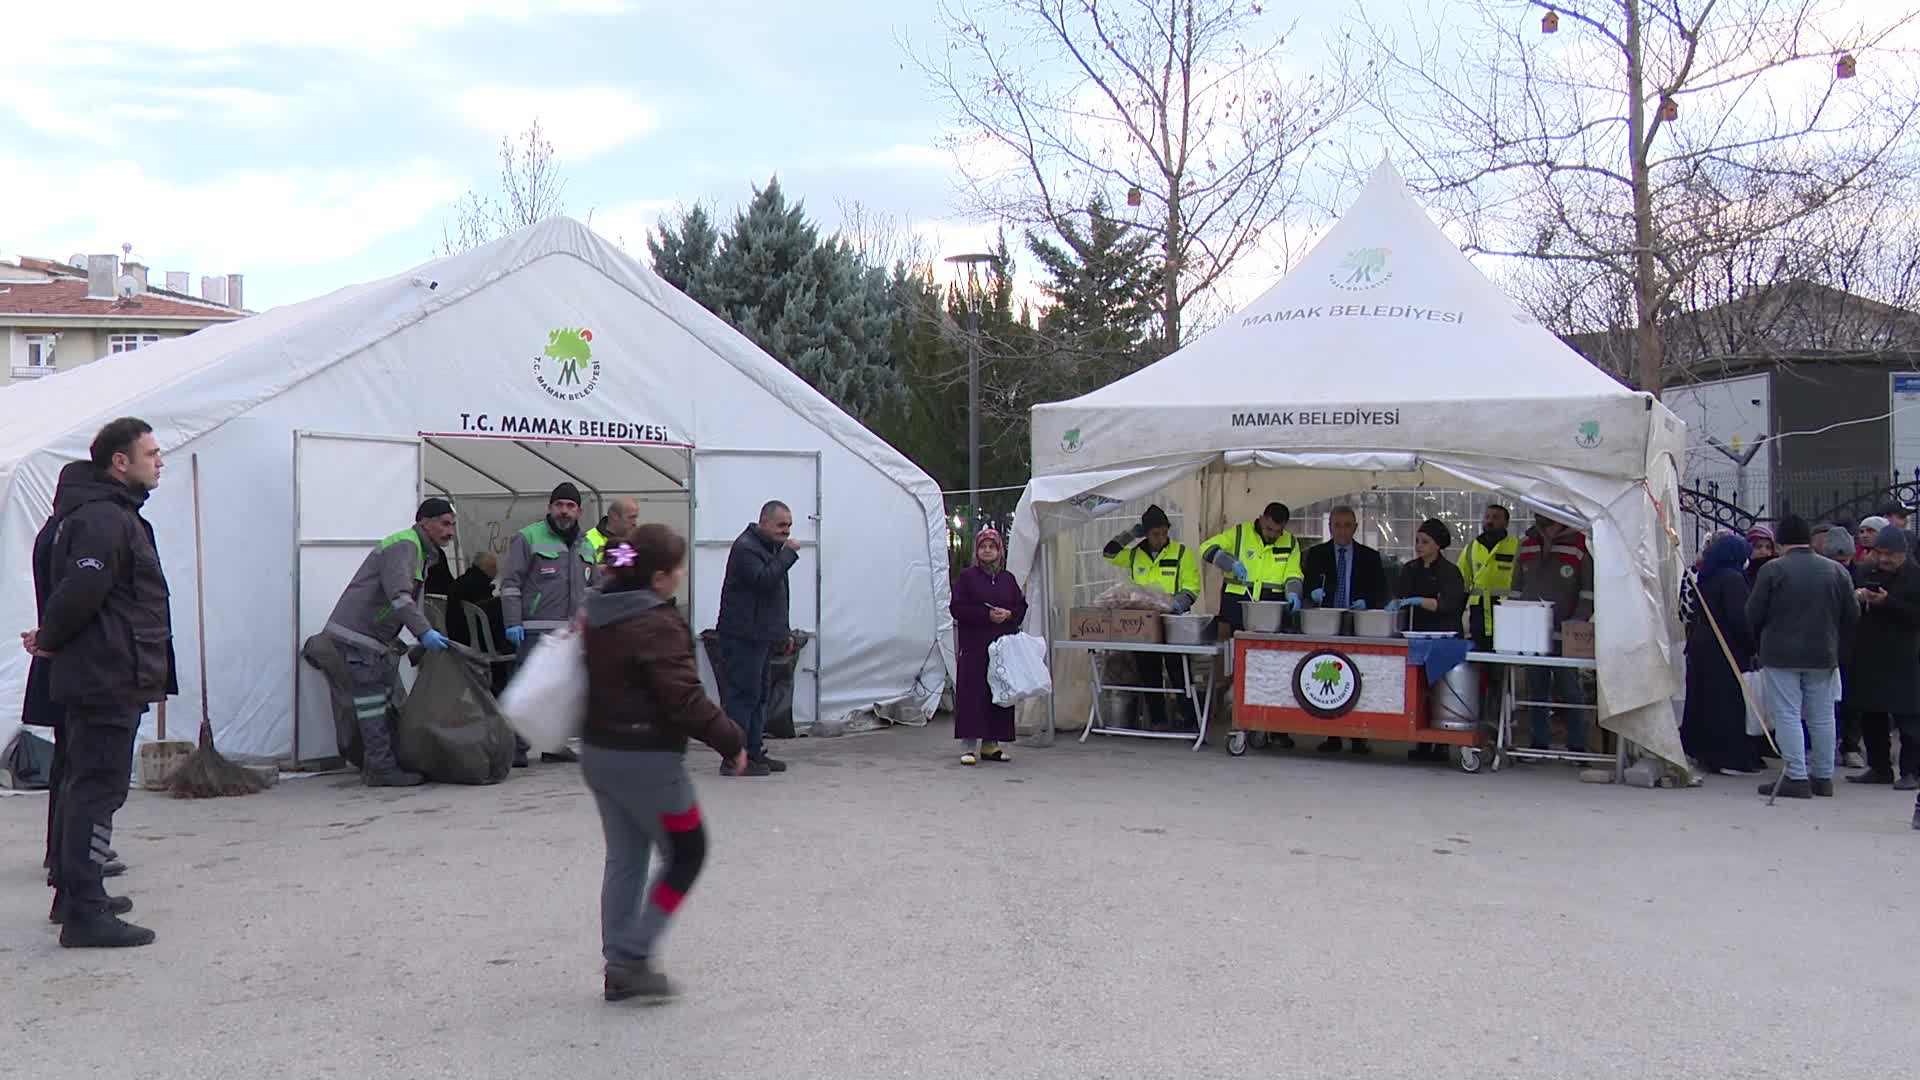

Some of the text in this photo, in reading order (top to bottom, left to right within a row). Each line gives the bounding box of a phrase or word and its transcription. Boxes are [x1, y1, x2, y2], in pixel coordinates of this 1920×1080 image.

[1242, 305, 1464, 327] MAMAK BELEDİYESİ
[536, 375, 566, 400] MAMAK
[460, 413, 494, 432] T.C.
[501, 415, 573, 436] MAMAK
[1232, 408, 1400, 427] MAMAK BELEDİYESİ
